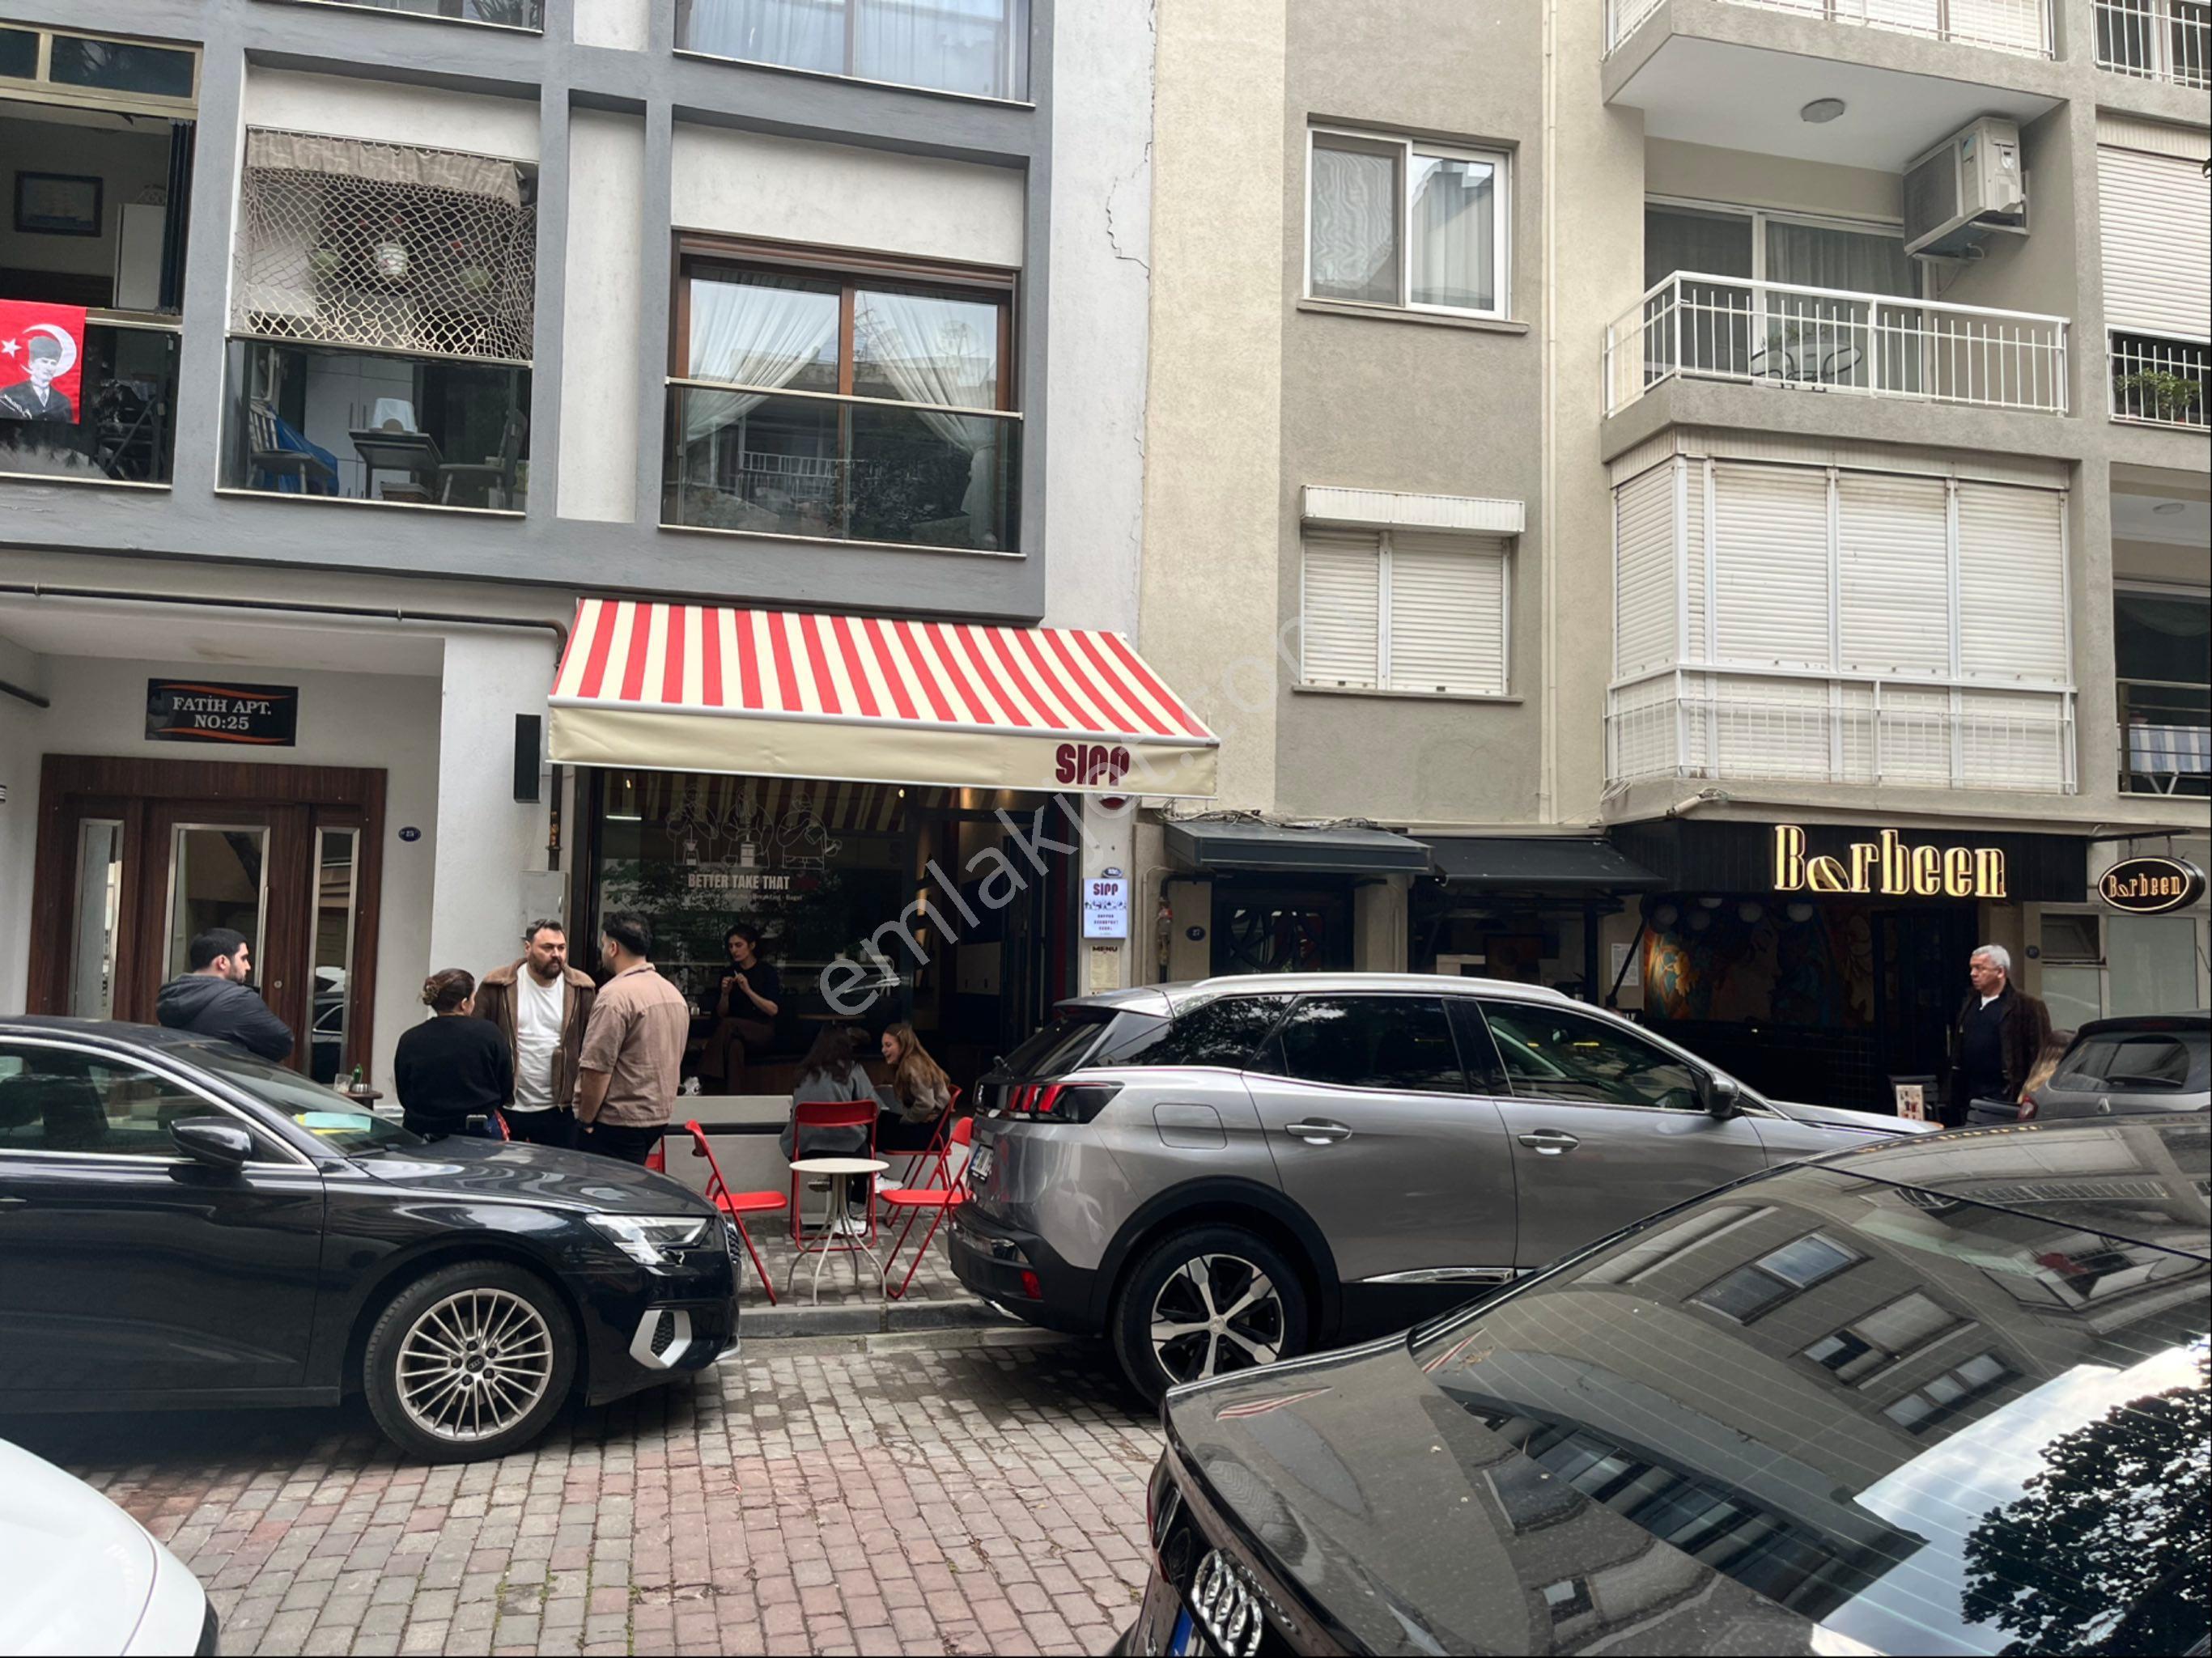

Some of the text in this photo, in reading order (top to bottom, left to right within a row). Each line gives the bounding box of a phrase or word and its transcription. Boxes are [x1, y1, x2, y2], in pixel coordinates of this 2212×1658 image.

[172, 695, 272, 715] FATİH APT.
[194, 715, 249, 730] NO:25
[1055, 743, 1130, 787] SIPP
[688, 873, 729, 889] BETTER
[732, 874, 759, 890] TAKE
[762, 876, 790, 890] THAT
[1093, 882, 1119, 896] SIPP
